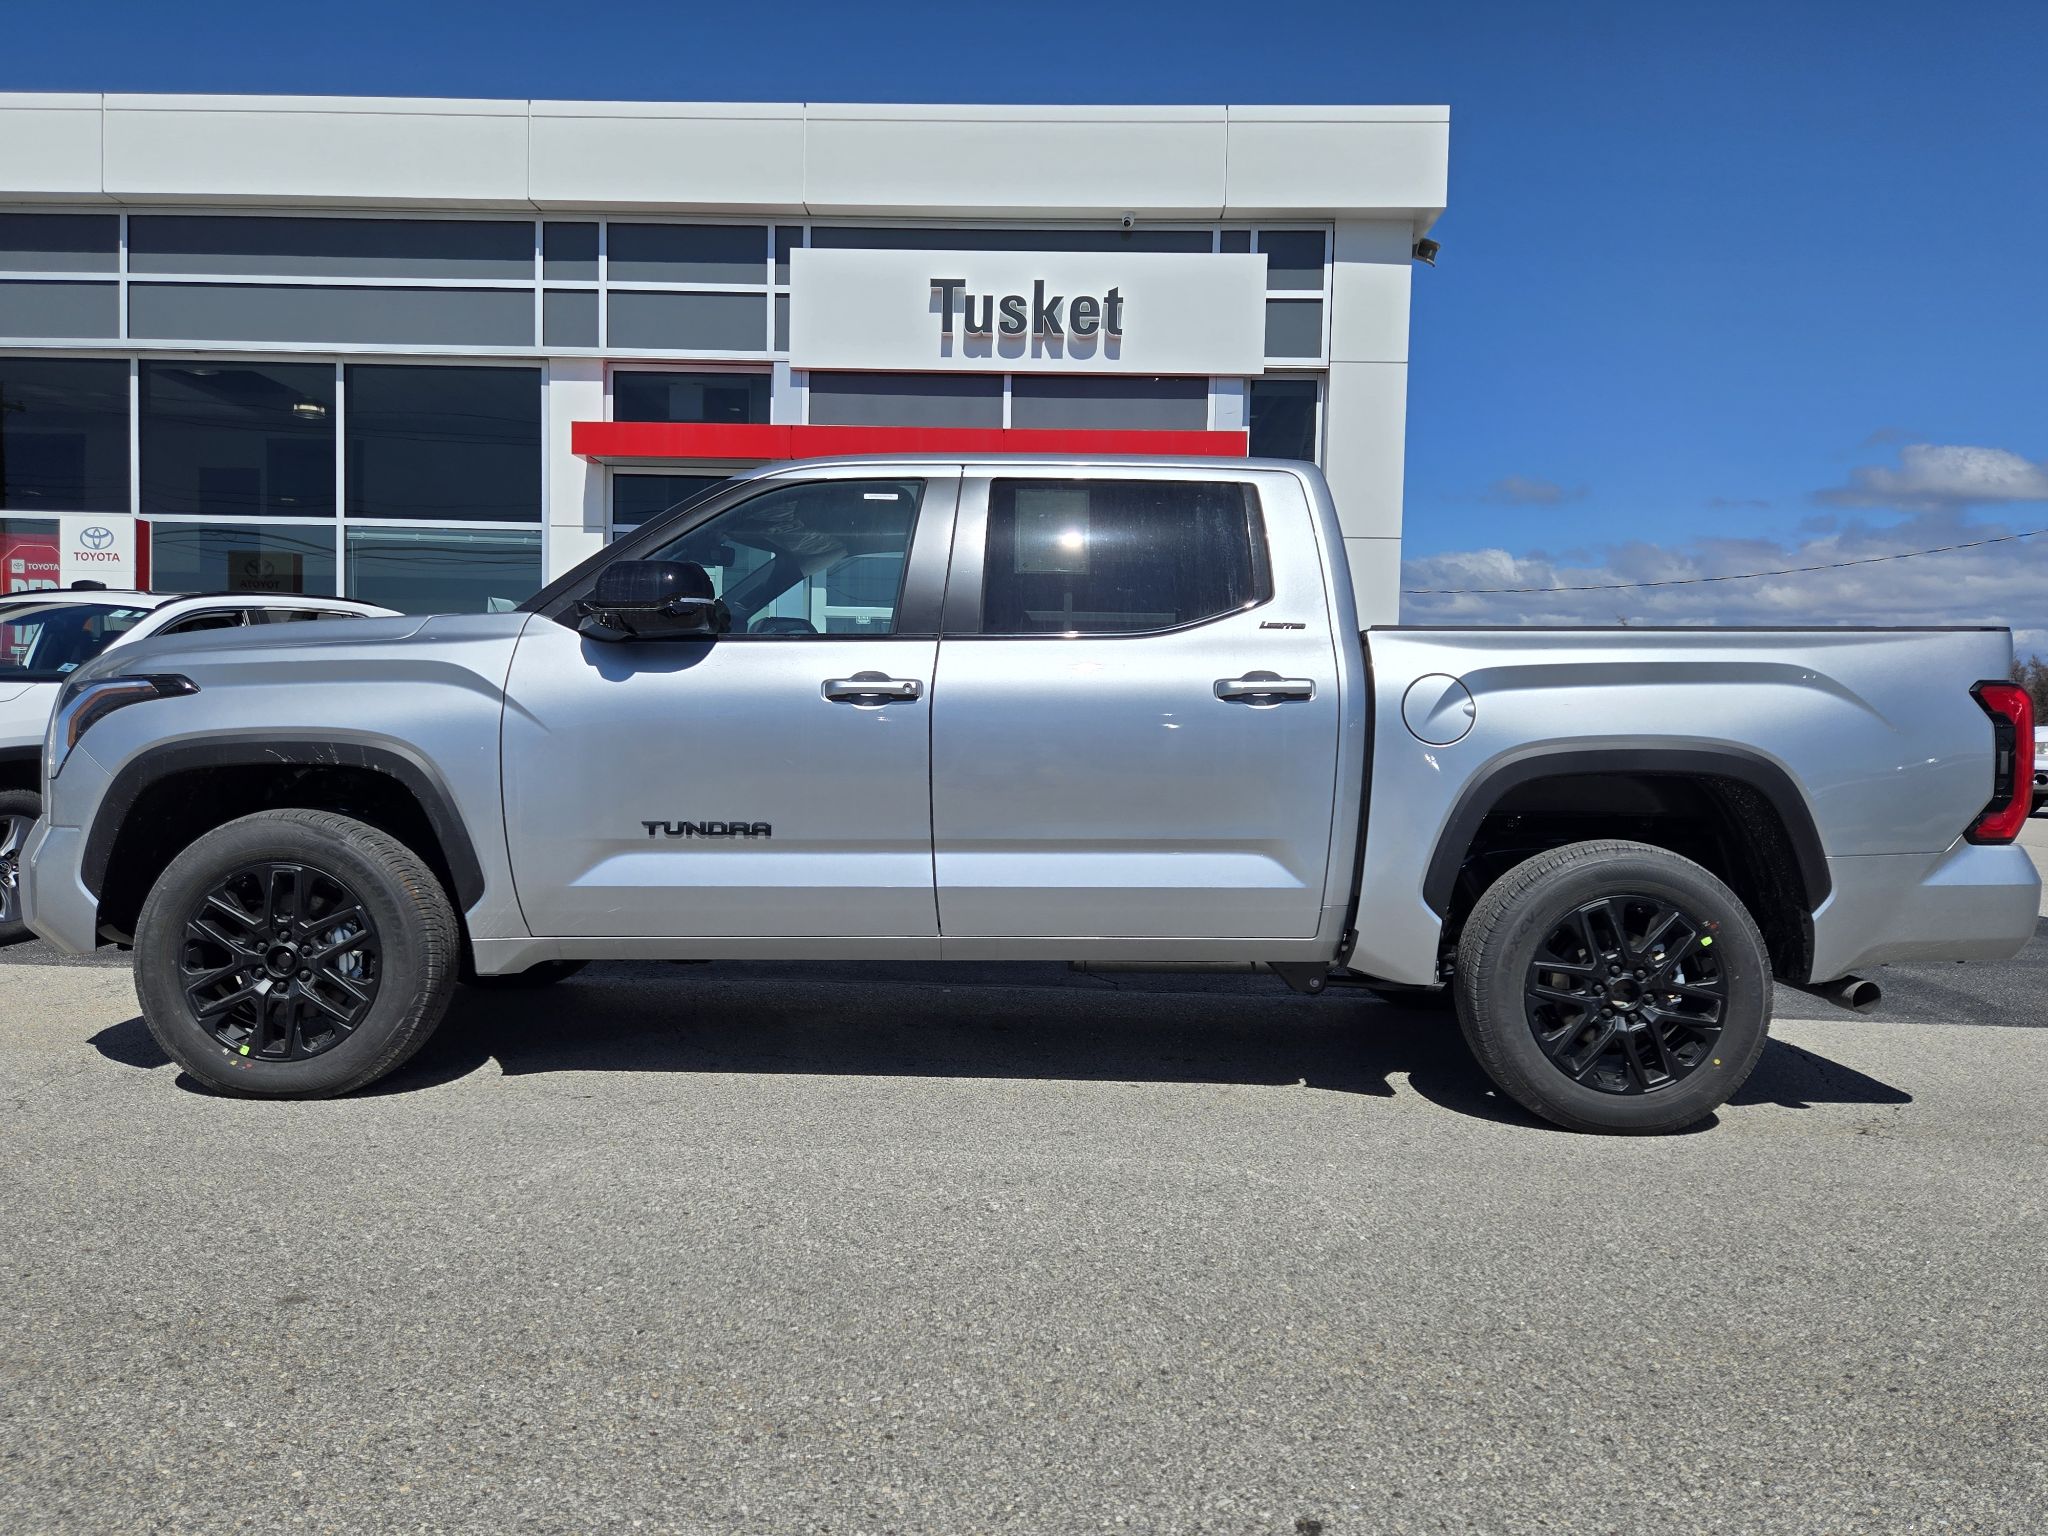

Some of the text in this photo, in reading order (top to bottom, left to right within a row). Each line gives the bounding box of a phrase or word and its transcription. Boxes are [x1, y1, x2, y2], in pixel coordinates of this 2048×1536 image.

[930, 278, 1124, 335] Tusket
[73, 552, 120, 562] TOYOTA
[28, 563, 60, 571] TOYOTA
[641, 821, 772, 836] TUNDRA
